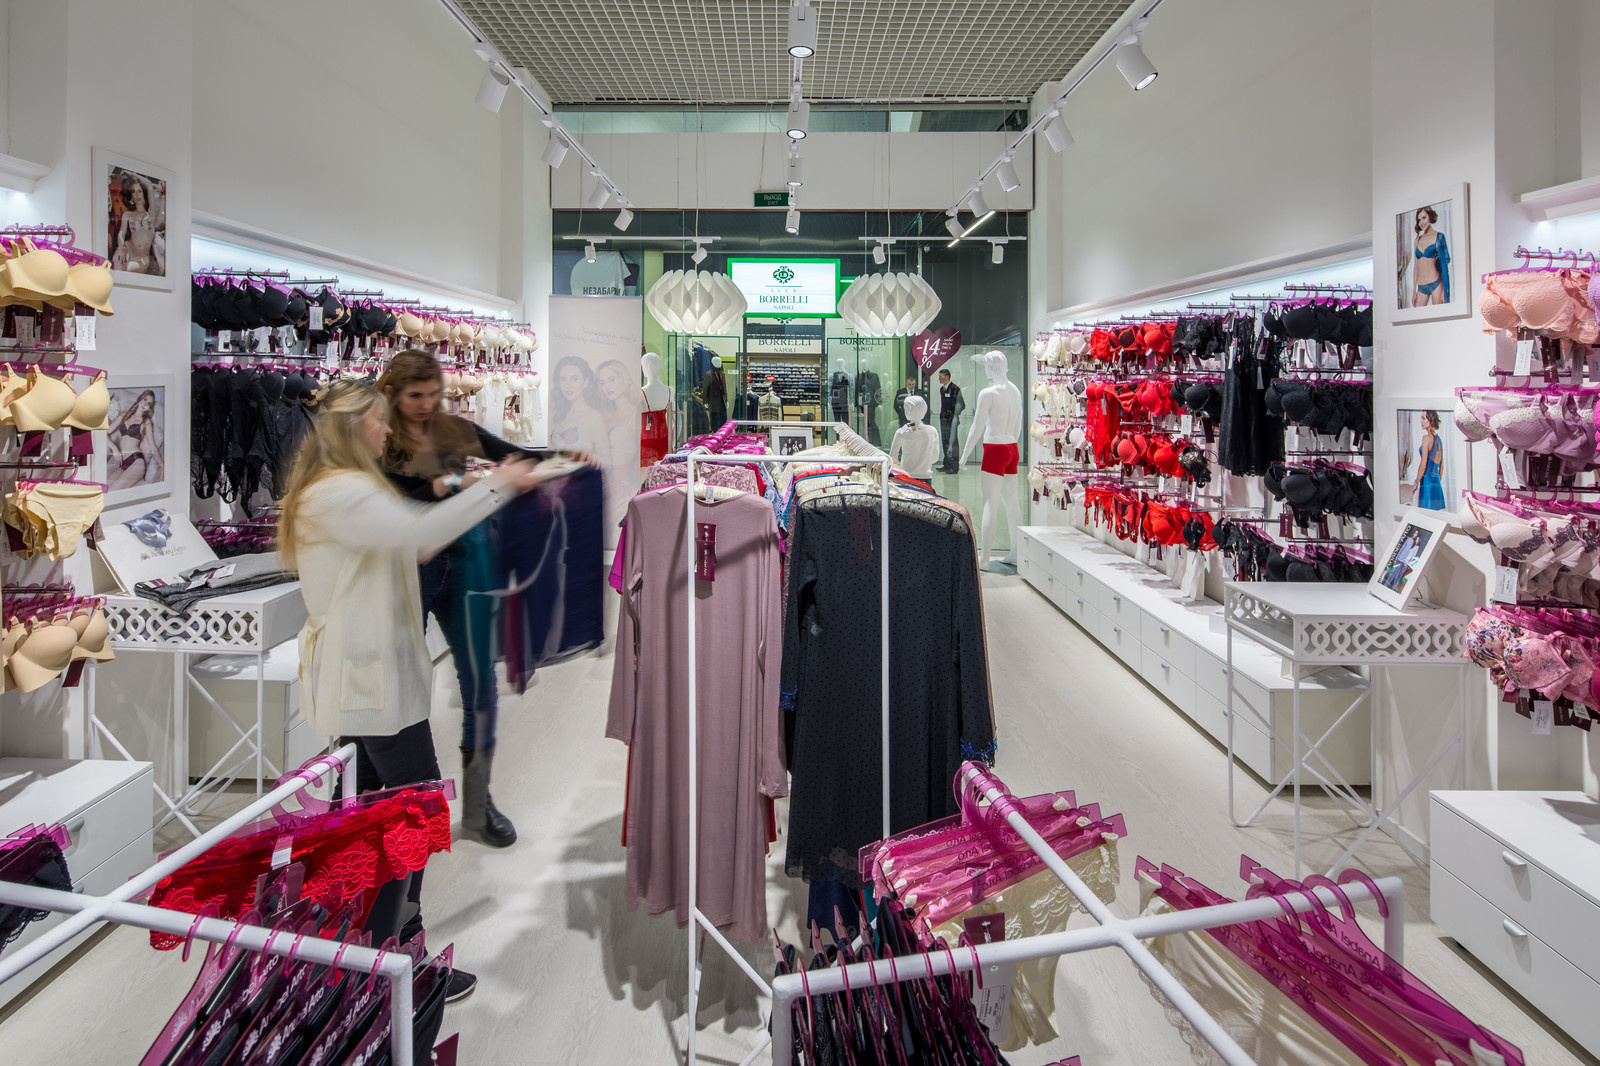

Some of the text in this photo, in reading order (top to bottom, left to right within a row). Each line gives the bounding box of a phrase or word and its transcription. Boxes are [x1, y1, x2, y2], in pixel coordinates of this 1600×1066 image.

[759, 295, 808, 304] BORRELLI
[758, 338, 811, 346] BORRELLI
[839, 338, 887, 346] BORRELLI
[916, 338, 941, 356] -14
[307, 986, 325, 1012] Arto
[352, 991, 371, 1018] Arto
